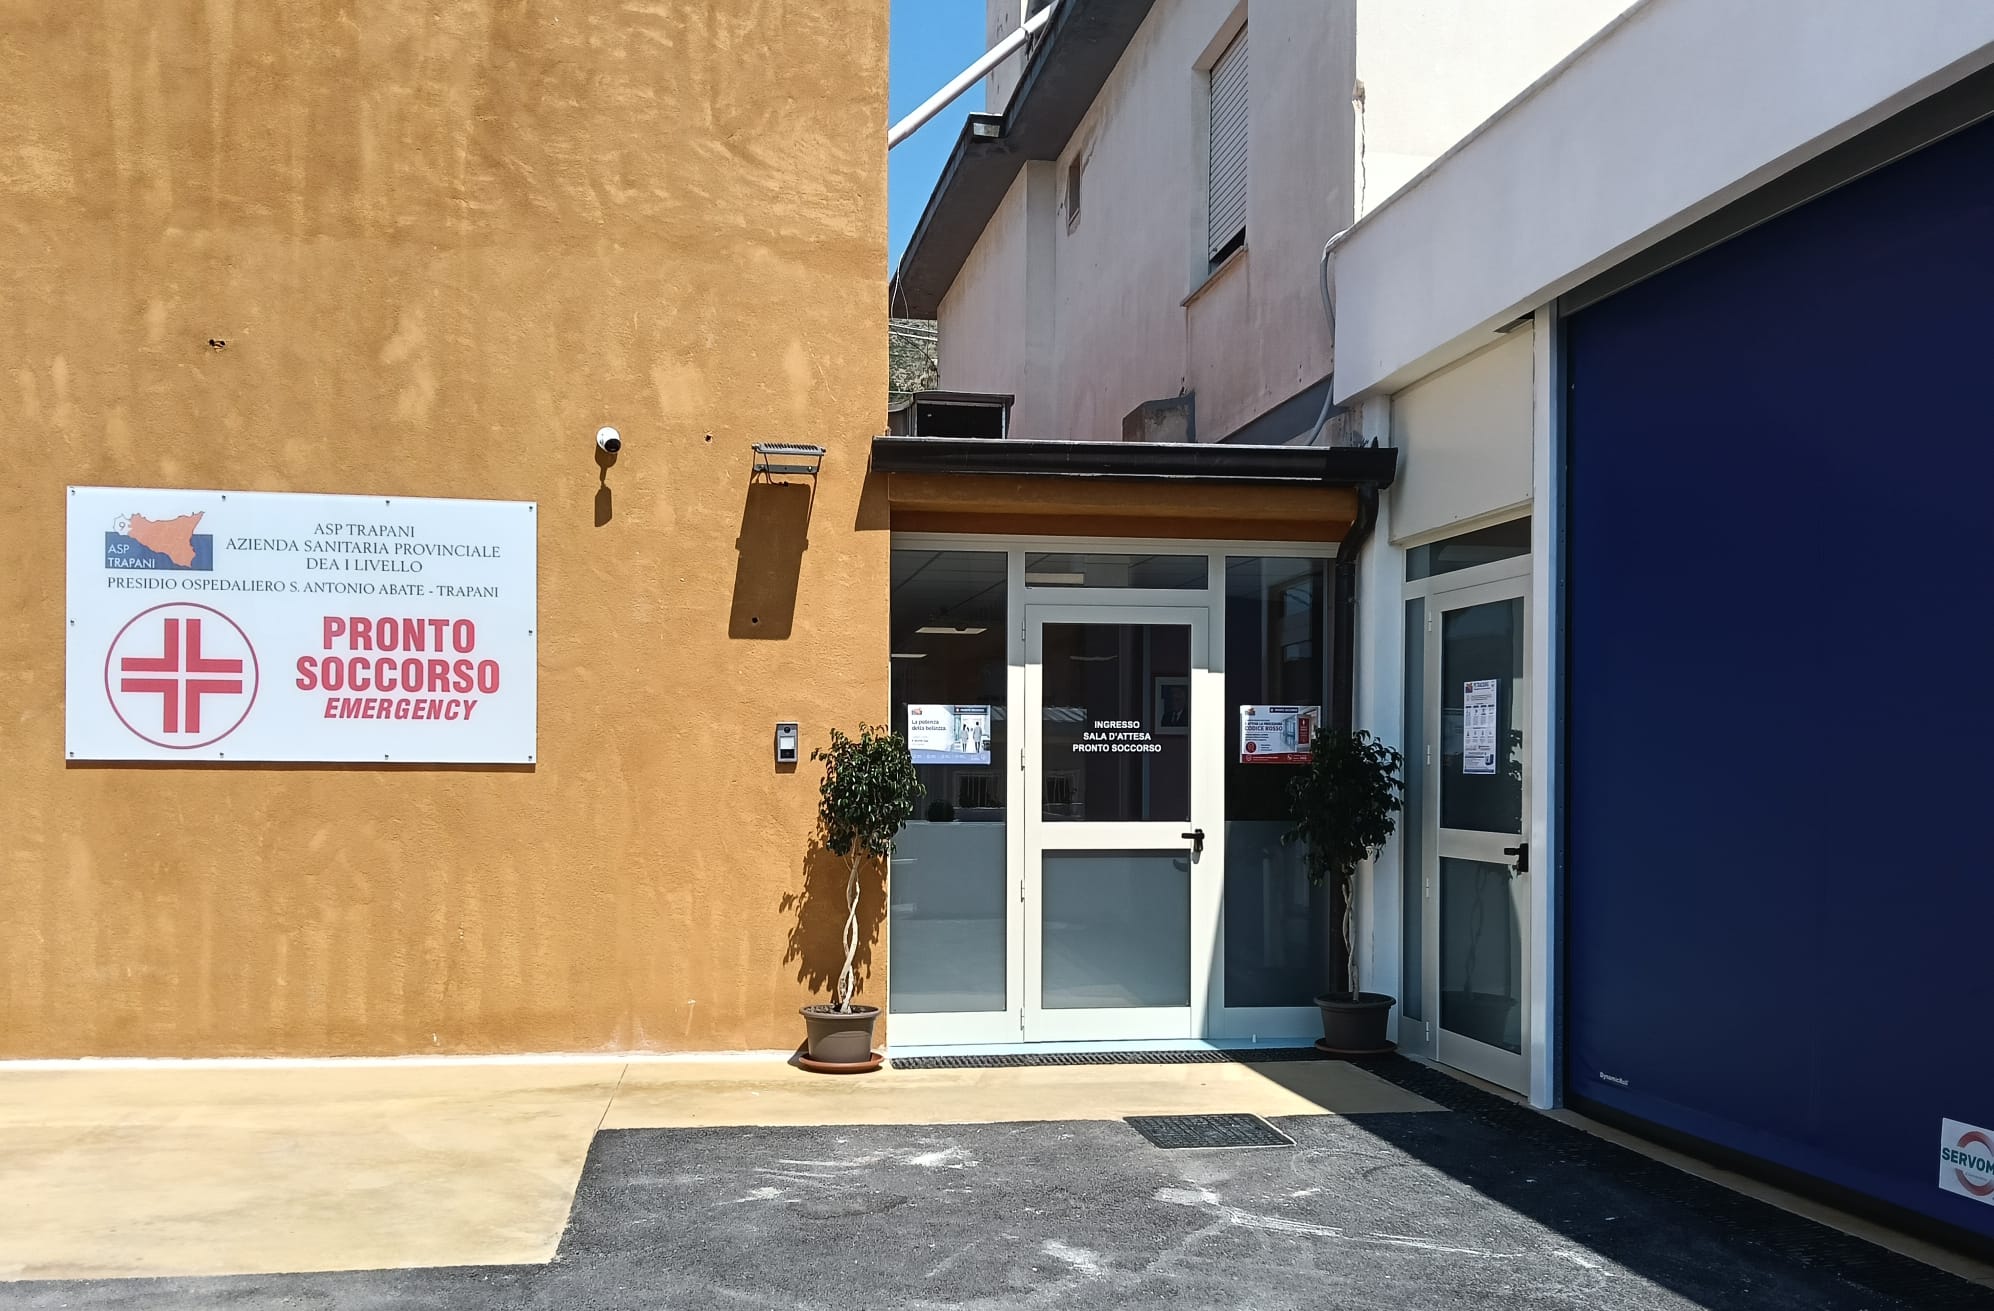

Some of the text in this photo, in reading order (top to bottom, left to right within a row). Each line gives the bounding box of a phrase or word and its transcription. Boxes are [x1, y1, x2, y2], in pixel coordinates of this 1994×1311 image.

[118, 520, 125, 530] 9
[314, 523, 415, 537] ASP TRAPANI
[108, 544, 130, 555] ASP
[226, 538, 501, 558] AZIENDA SANITARIA PROVINCIALE
[108, 557, 155, 569] TRAPANI
[306, 557, 423, 573] DEA I LIVELLO
[107, 577, 178, 590] PRESIDIO
[181, 579, 286, 593] OSPEDALIERO
[289, 581, 300, 593] S.
[303, 582, 376, 595] ANTONIO
[379, 583, 425, 596] ABATE
[436, 585, 499, 598] TRAPANI
[323, 615, 476, 654] PRONTO
[295, 655, 501, 694] SOCCORSO
[323, 697, 478, 721] EMERGENCY
[1094, 720, 1141, 729] INGRESSO
[1083, 732, 1152, 741] SALA D'ATTESA
[1072, 744, 1162, 752] PRONTO SOCCORSO
